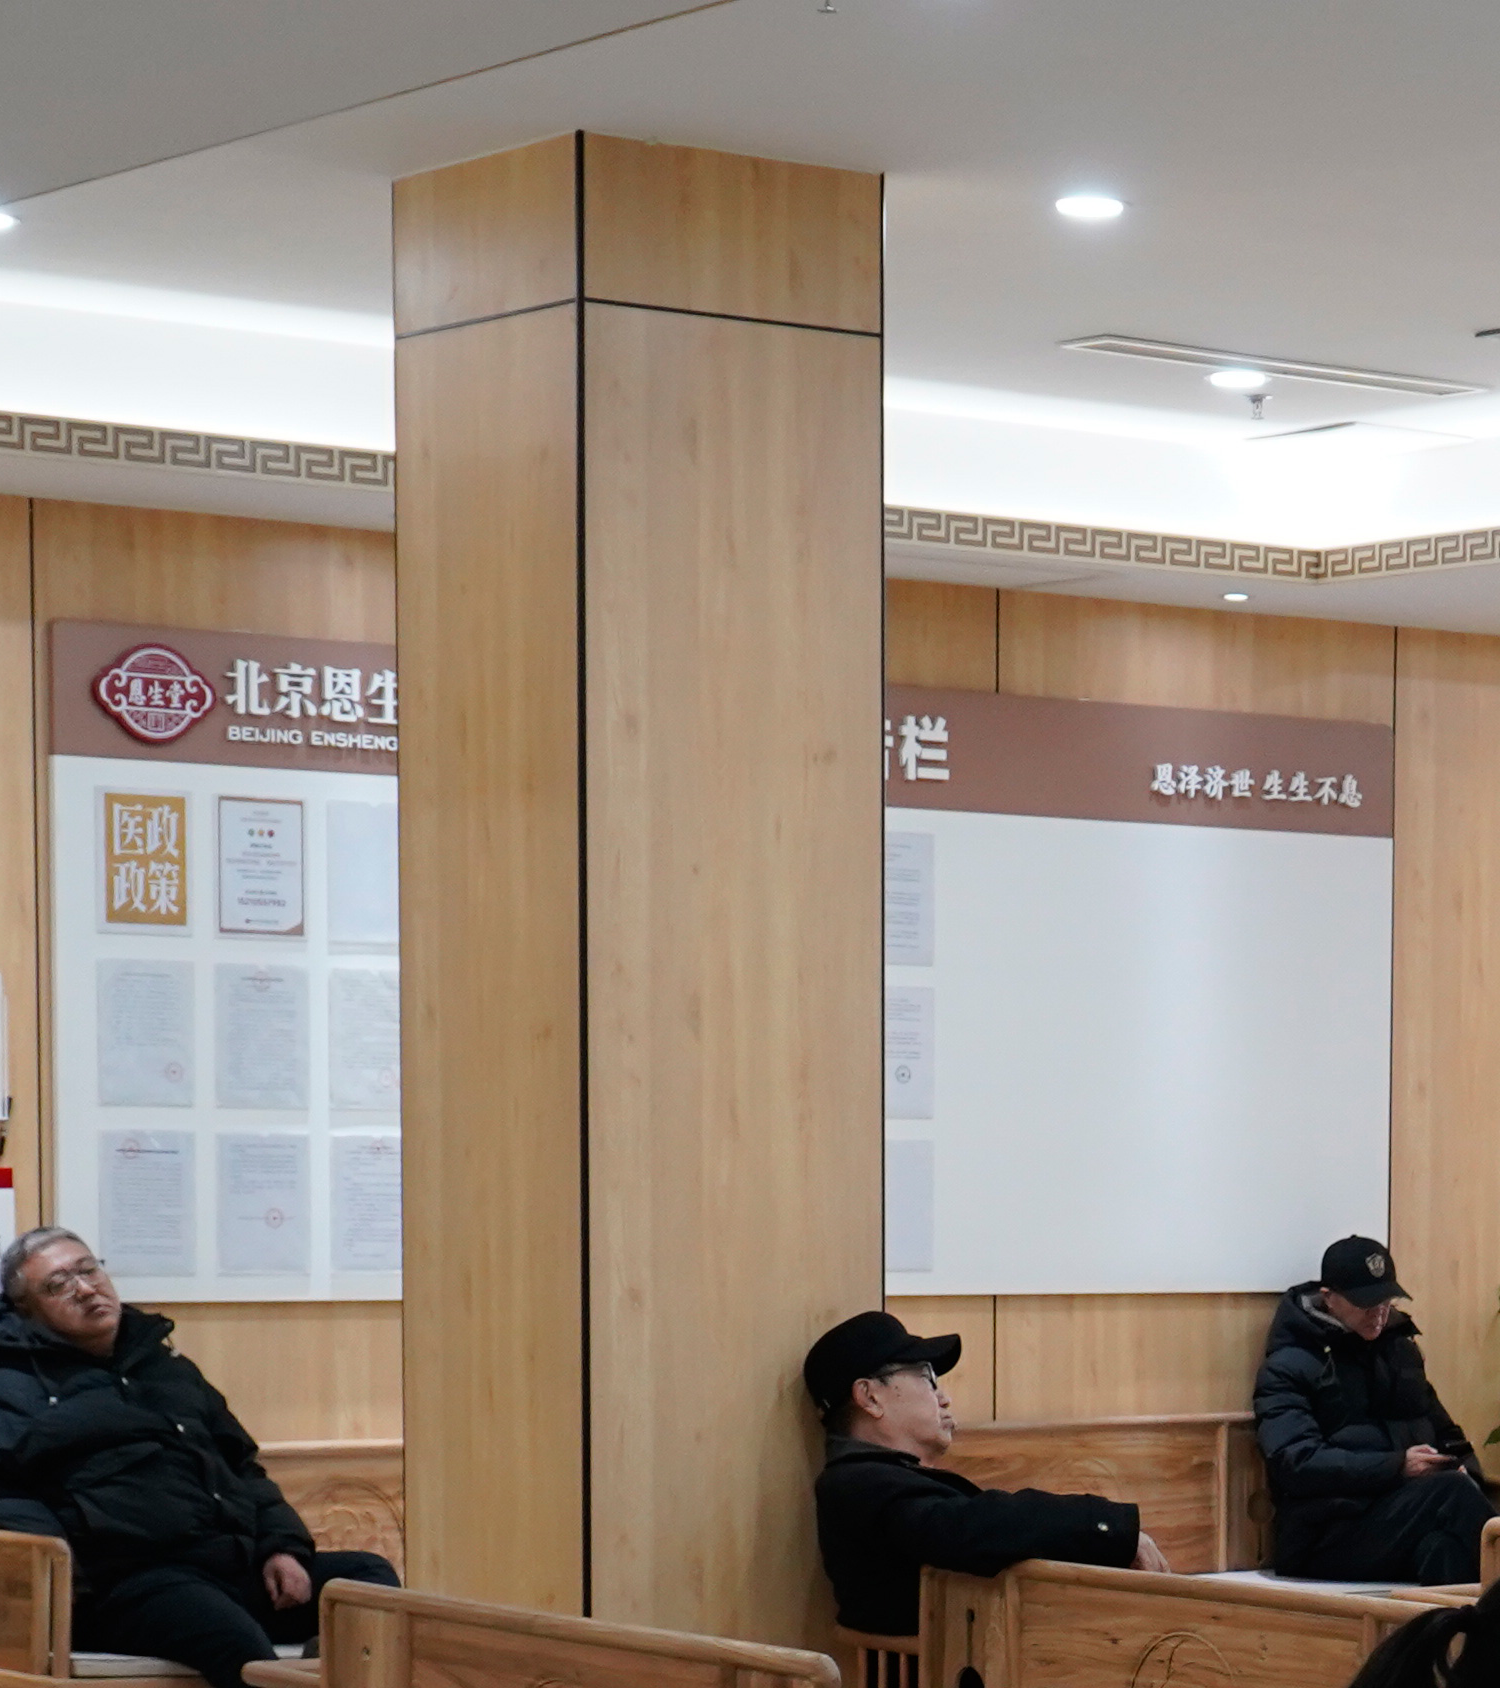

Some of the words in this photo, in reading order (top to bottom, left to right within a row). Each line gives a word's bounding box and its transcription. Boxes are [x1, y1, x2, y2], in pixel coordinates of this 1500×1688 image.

[228, 726, 303, 745] BEIJING
[884, 713, 950, 781] 栏
[1151, 763, 1255, 800] 恩泽济世
[1261, 769, 1363, 808] 生生不息
[112, 802, 179, 858] 医政
[112, 859, 179, 916] 政策
